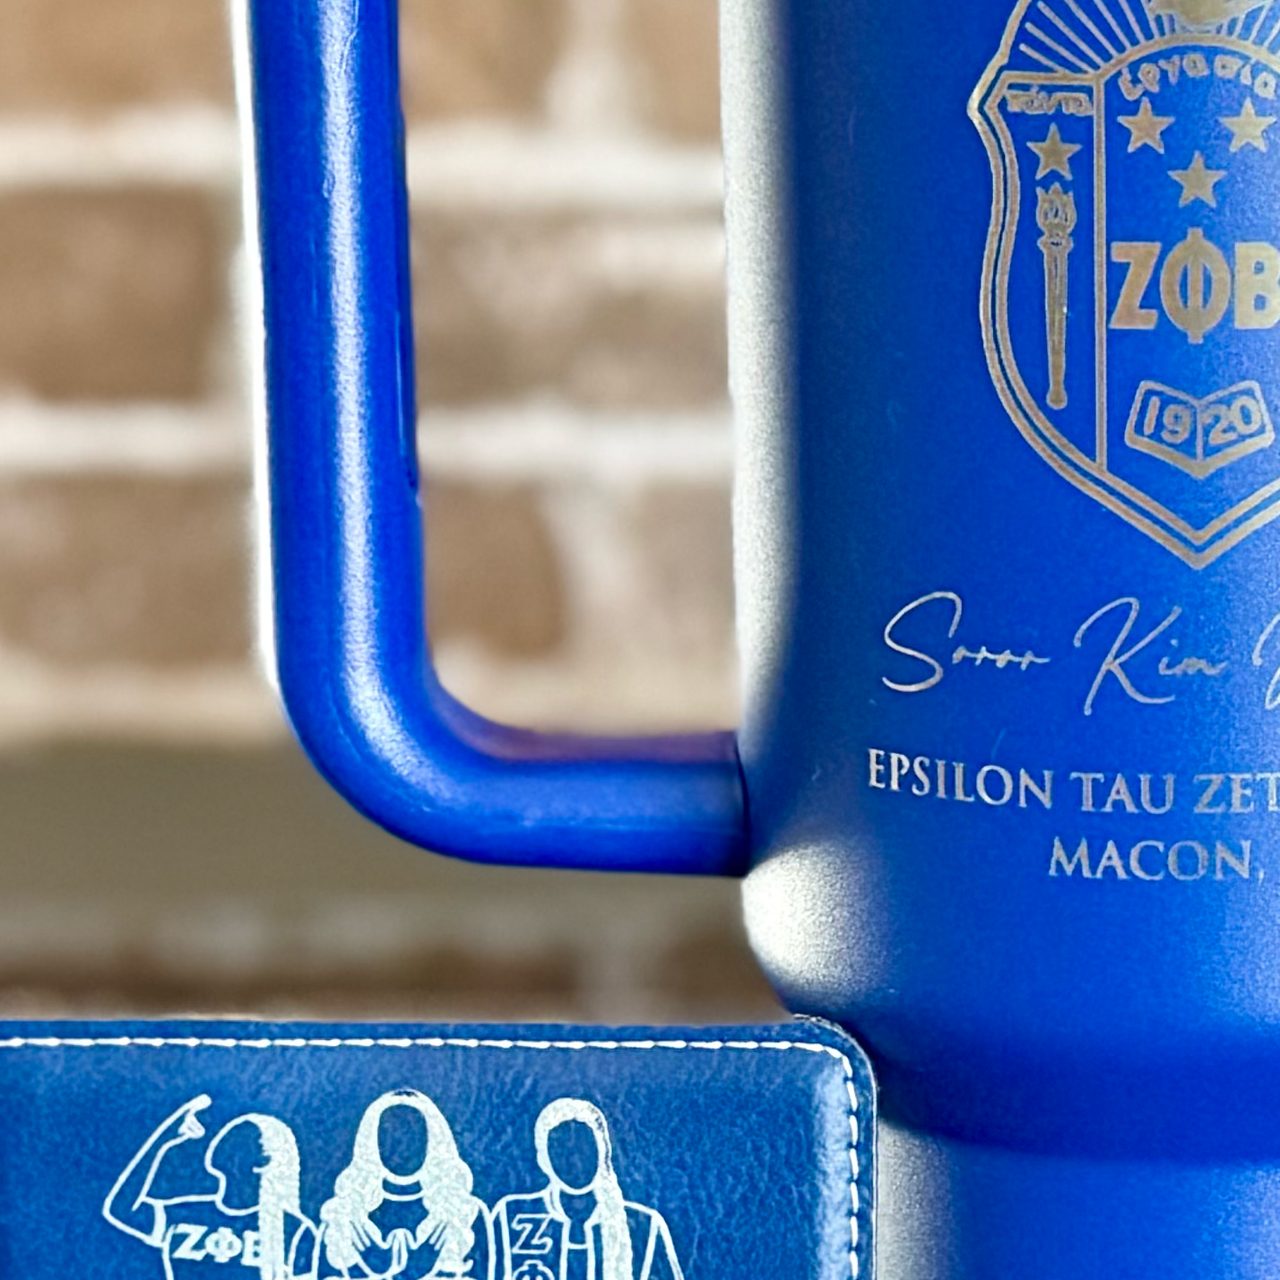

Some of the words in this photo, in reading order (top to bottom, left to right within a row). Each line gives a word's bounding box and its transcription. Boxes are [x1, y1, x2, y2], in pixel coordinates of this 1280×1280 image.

[1140, 396, 1260, 443] 1920
[1074, 596, 1227, 716] Kim
[867, 748, 1054, 810] EPSILON
[1070, 771, 1175, 815] TAU
[1048, 835, 1265, 885] MACON,
